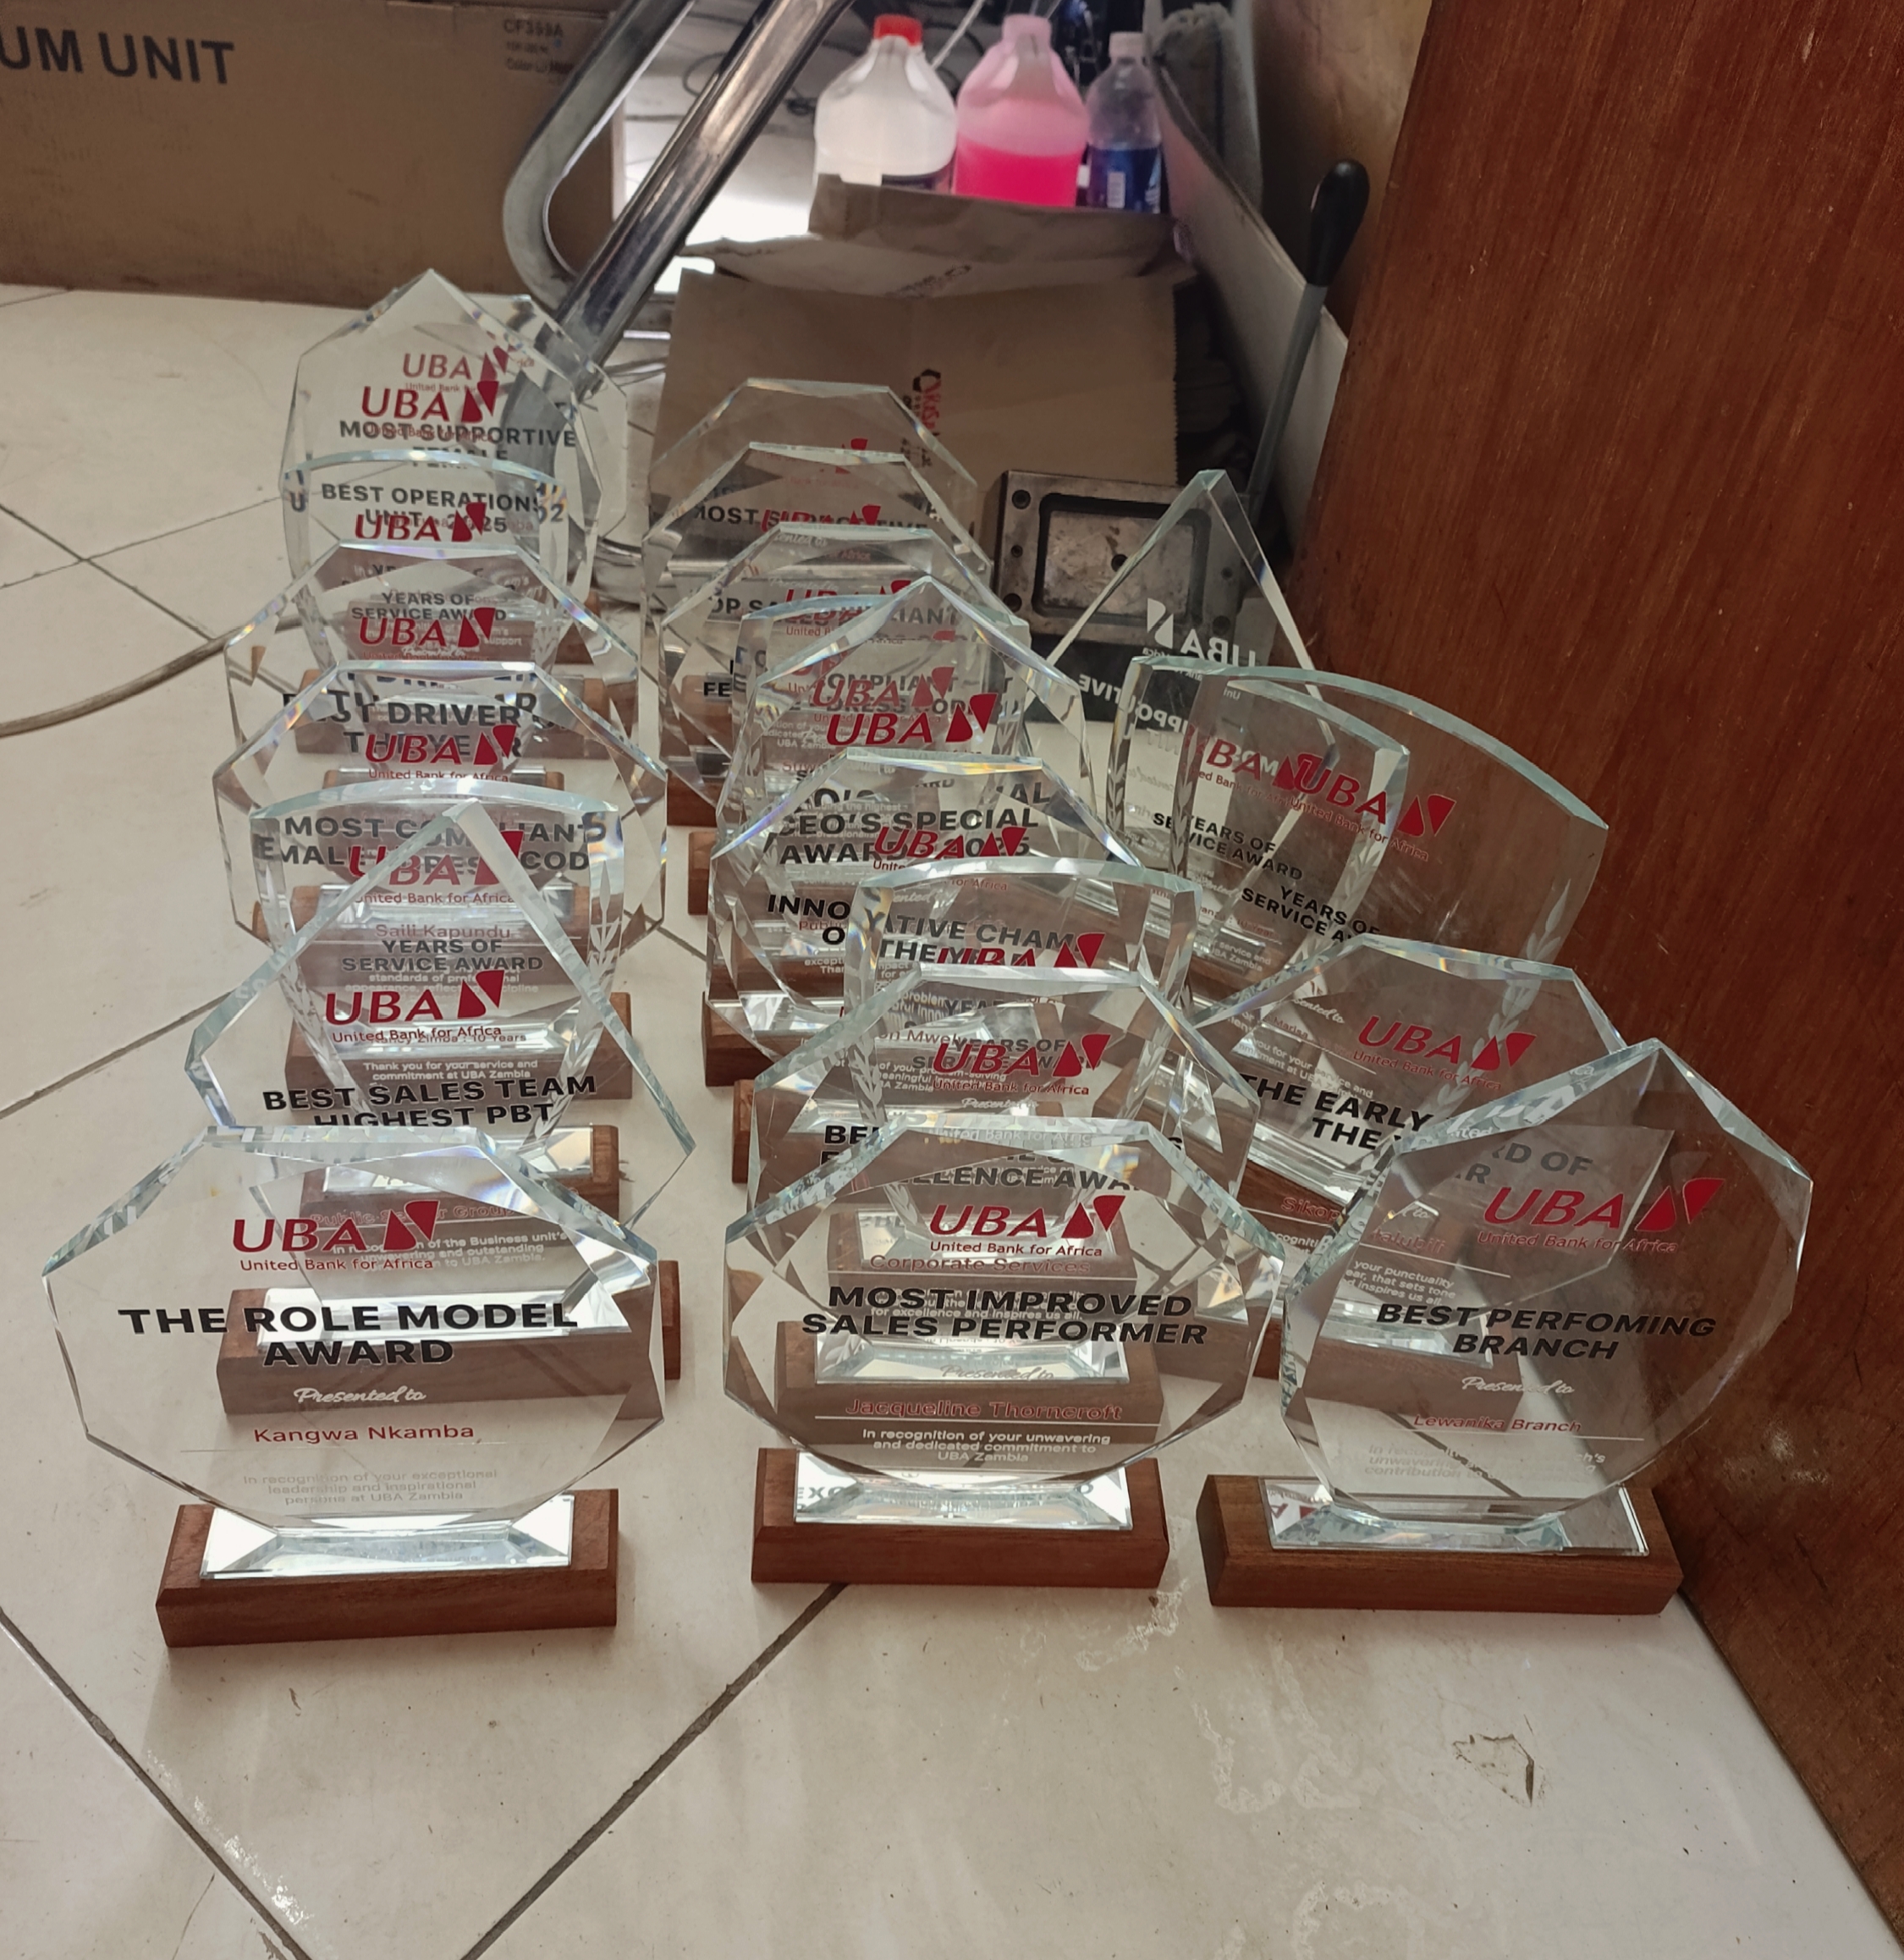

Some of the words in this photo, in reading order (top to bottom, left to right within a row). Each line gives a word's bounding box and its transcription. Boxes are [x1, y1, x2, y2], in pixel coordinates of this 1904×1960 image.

[99, 32, 234, 84] UNIT
[403, 353, 472, 380] UBA
[361, 386, 449, 422] UBA
[339, 421, 412, 441] MOST
[424, 424, 576, 447] SUPPORTIVE
[322, 483, 384, 503] BEST
[355, 514, 442, 542] UBA
[382, 592, 445, 606] YEARS
[450, 593, 475, 606] OF
[351, 608, 433, 621] SERVICE
[359, 617, 448, 647] UBA
[786, 625, 822, 636] United
[812, 679, 900, 707] UBA
[388, 702, 521, 728] DRIVER
[826, 712, 934, 746] UBA
[365, 734, 463, 766] UBA
[369, 768, 410, 779] United
[415, 770, 446, 779] Bank
[472, 773, 509, 784] Africa
[1294, 758, 1388, 824] UBA
[285, 816, 384, 838] MOST
[779, 812, 882, 837] CEO'S
[893, 808, 1039, 833] SPECIAL
[874, 826, 966, 861] UBA
[1250, 837, 1276, 854] OF
[1335, 814, 1366, 834] Bank
[1391, 837, 1429, 862] Africa
[1232, 848, 1303, 880] AWARD
[971, 878, 1009, 892] Africa
[408, 893, 443, 904] Bank
[448, 893, 467, 904] for
[472, 892, 515, 904] Africa
[1280, 885, 1347, 926] YEARS
[1241, 887, 1327, 936] SERVICE
[376, 924, 416, 938] Saili
[424, 924, 510, 940] Kapundu
[382, 939, 464, 954] YEARS
[471, 939, 503, 953] OF
[342, 957, 447, 972] SERVICE
[454, 956, 543, 971] AWARD
[1229, 953, 1263, 972] Zambia
[1254, 952, 1271, 965] and
[369, 974, 429, 983] standards
[324, 988, 443, 1025] UBA
[332, 1030, 384, 1043] United
[390, 1028, 426, 1041] Bank
[432, 1027, 453, 1038] for
[458, 1026, 502, 1038] Africa
[1036, 1038, 1066, 1052] OF
[1356, 1016, 1462, 1065] UBA
[364, 1062, 399, 1071] Thank
[402, 1063, 423, 1073] you
[426, 1061, 442, 1071] for
[474, 1060, 515, 1071] service
[517, 1060, 538, 1070] and
[933, 1042, 1039, 1076] UBA
[1353, 1050, 1400, 1071] United
[1403, 1060, 1437, 1076] Bank
[1439, 1067, 1460, 1082] for
[1461, 1073, 1502, 1091] Africa
[372, 1071, 444, 1081] commitment
[447, 1071, 459, 1080] at
[461, 1071, 487, 1080] UBA
[489, 1070, 531, 1079] Zambia
[1272, 1046, 1288, 1059] for
[1288, 1054, 1313, 1071] your
[1355, 1084, 1374, 1099] and
[262, 1087, 355, 1111] BEST
[369, 1082, 486, 1106] SALES
[494, 1076, 597, 1098] TEAM
[984, 1082, 1018, 1093] Bank
[1023, 1082, 1042, 1093] for
[1046, 1084, 1090, 1096] Africa
[314, 1107, 475, 1127] HIGHEST
[487, 1103, 554, 1125] PBT
[1313, 1090, 1434, 1132] EARLY
[1310, 1117, 1382, 1150] THE
[1540, 1148, 1593, 1176] OF
[1482, 1186, 1626, 1230] UBA
[930, 1203, 1048, 1239] UBA
[233, 1218, 367, 1253] UBA
[427, 1238, 441, 1248] of
[443, 1238, 466, 1248] the
[470, 1234, 528, 1247] Business
[1476, 1230, 1538, 1248] United
[1544, 1233, 1589, 1250] Bank
[1594, 1236, 1625, 1252] for
[1626, 1237, 1678, 1254] Africa
[439, 1247, 463, 1258] and
[466, 1242, 544, 1258] outstanding
[930, 1241, 982, 1253] United
[988, 1242, 1024, 1255] Bank
[1030, 1244, 1052, 1256] for
[1055, 1244, 1103, 1258] Africa
[239, 1258, 298, 1271] United
[305, 1258, 345, 1270] Bank
[352, 1258, 377, 1269] for
[382, 1257, 433, 1269] Africa
[462, 1256, 490, 1267] UBA
[869, 1254, 986, 1272] Corporate
[993, 1258, 1091, 1275] Services
[1354, 1260, 1383, 1275] your
[1384, 1266, 1455, 1290] punctuality
[1372, 1272, 1396, 1286] that
[1399, 1280, 1426, 1293] sets
[1428, 1285, 1457, 1299] tone
[828, 1286, 952, 1311] MOST
[966, 1288, 1193, 1318] IMPROVED
[1357, 1281, 1406, 1301] inspires
[1408, 1292, 1424, 1302] us
[118, 1308, 228, 1334] THE
[245, 1306, 381, 1332] ROLE
[398, 1302, 578, 1330] MODEL
[892, 1308, 961, 1319] excellence
[965, 1308, 988, 1319] and
[992, 1308, 1042, 1322] inspires
[1045, 1310, 1060, 1320] us
[1376, 1304, 1478, 1328] BEST
[1485, 1308, 1717, 1338] PERFOMING
[801, 1313, 943, 1337] SALES
[951, 1319, 1208, 1346] PERFORMER
[263, 1339, 454, 1367] AWARD
[1452, 1334, 1620, 1361] BRANCH
[940, 1363, 1032, 1381] Presented
[1034, 1366, 1054, 1380] to
[293, 1386, 404, 1405] Presented
[403, 1387, 426, 1402] to
[845, 1399, 981, 1418] Jacqueline
[989, 1401, 1123, 1420] Thorncroft
[254, 1428, 358, 1444] Kangwa
[368, 1424, 474, 1440] Nkamba
[1414, 1415, 1505, 1430] Lewanika
[1511, 1418, 1582, 1433] Branch
[862, 1429, 876, 1439] In
[880, 1429, 965, 1442] recognition
[969, 1431, 985, 1442] of
[988, 1433, 1022, 1445] your
[1026, 1433, 1111, 1445] unwavering
[873, 1440, 902, 1450] and
[905, 1440, 982, 1452] dedicated
[983, 1441, 1078, 1453] commitment
[1081, 1444, 1097, 1454] to
[938, 1451, 970, 1461] UBA
[974, 1451, 1030, 1462] Zambia
[244, 1475, 256, 1484] In
[262, 1473, 348, 1486] recognition
[354, 1473, 370, 1482] of
[373, 1472, 407, 1484] your
[413, 1469, 498, 1483] exceptional
[268, 1484, 347, 1495] leadership
[352, 1482, 381, 1492] and
[386, 1480, 476, 1495] inspirational
[351, 1493, 365, 1502] at
[371, 1492, 404, 1501] UBA
[408, 1490, 463, 1501] Zambia
